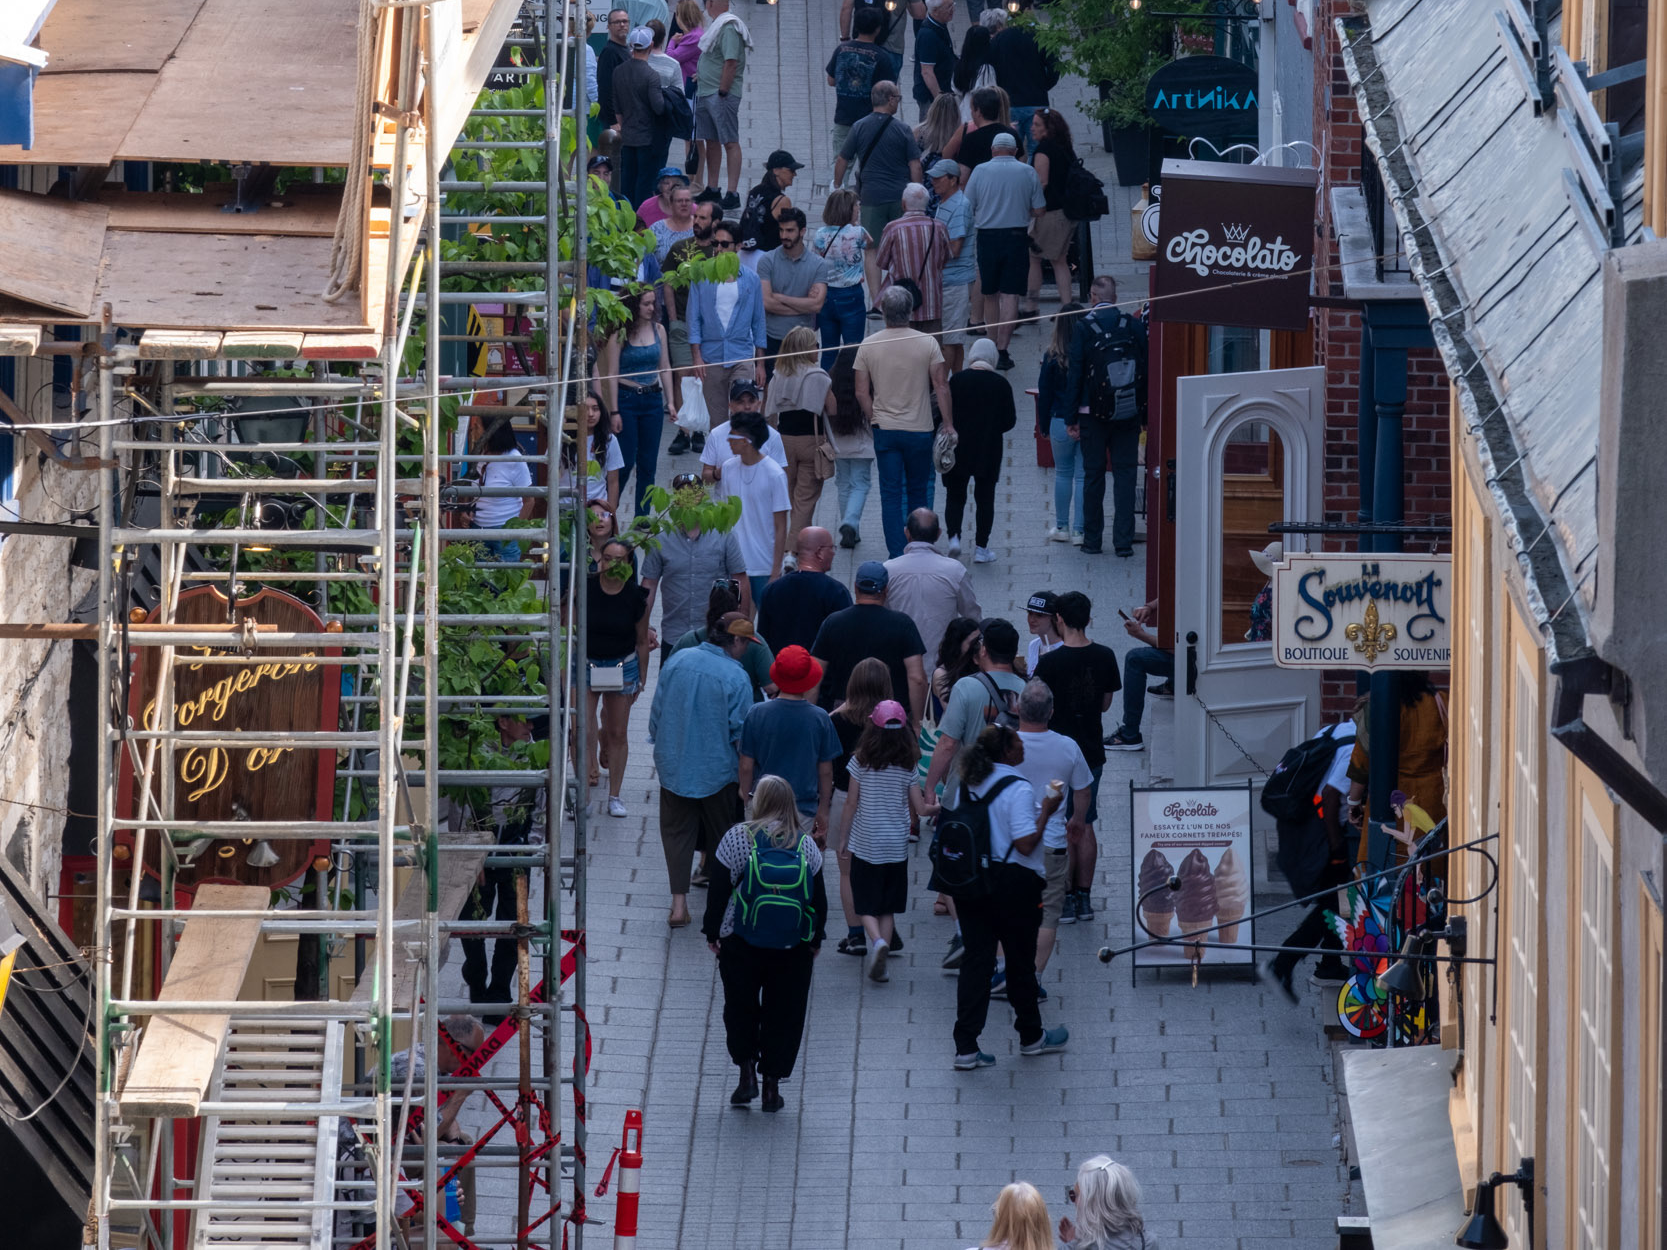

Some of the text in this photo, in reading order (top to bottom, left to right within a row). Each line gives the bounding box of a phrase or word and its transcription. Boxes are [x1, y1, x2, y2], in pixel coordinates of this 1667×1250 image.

[1166, 228, 1301, 276] Chocolato
[1285, 647, 1349, 661] BOUTIQUE
[1163, 802, 1219, 821] Chocolato
[1207, 830, 1243, 838] TREMPÉS!
